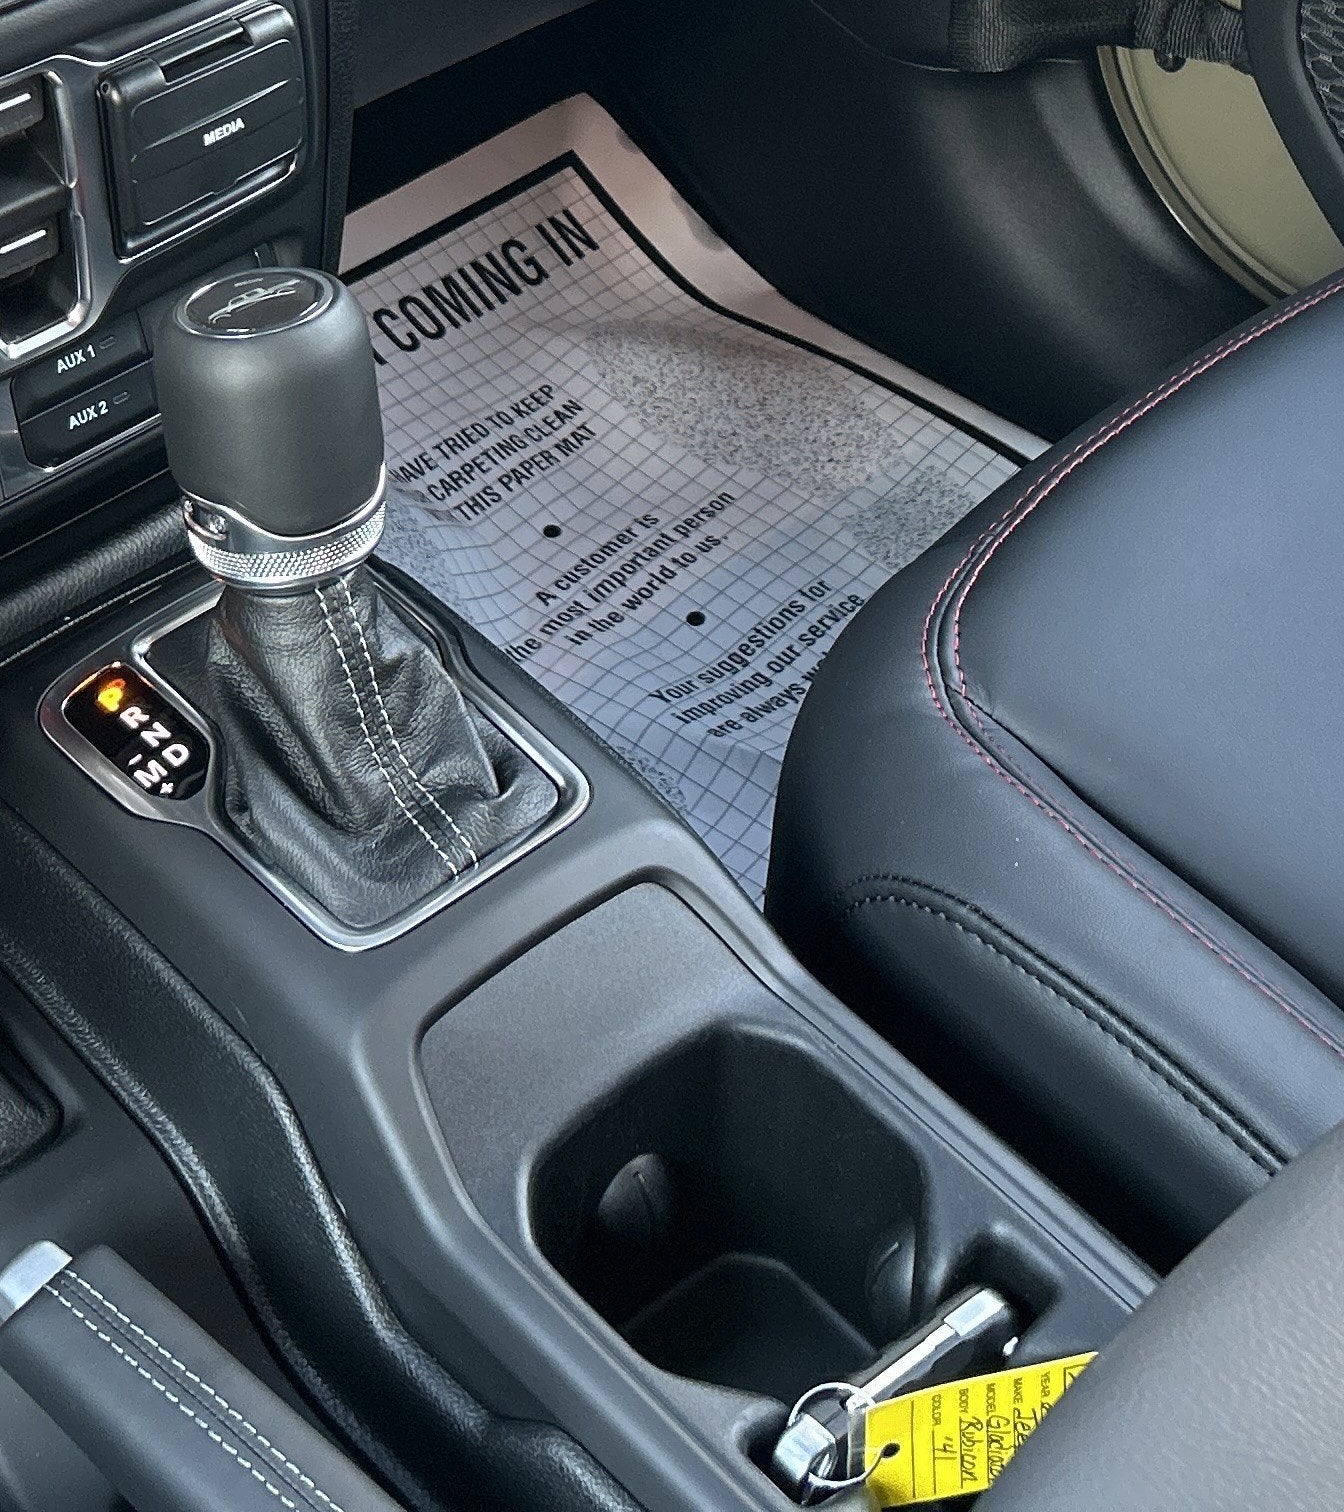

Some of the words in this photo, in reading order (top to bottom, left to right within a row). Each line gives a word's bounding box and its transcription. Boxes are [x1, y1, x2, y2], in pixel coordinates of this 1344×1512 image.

[202, 116, 246, 146] MEDIA
[374, 238, 550, 354] COMING
[540, 210, 600, 271] IN
[56, 350, 86, 374] AUX
[87, 345, 96, 360] 1
[67, 408, 97, 431] AUX
[98, 401, 109, 418] 2
[431, 422, 491, 462] TRIED
[485, 410, 516, 431] TO
[510, 384, 556, 419] KEEP
[426, 434, 528, 502] CARPETING
[523, 399, 584, 443] CLEAN
[454, 483, 503, 522] THIS
[497, 448, 561, 494] PAPER
[554, 422, 598, 458] MAT
[535, 590, 558, 607] A
[554, 527, 640, 592] customer
[634, 512, 660, 530] is
[538, 599, 592, 637] most
[583, 533, 678, 604] important
[671, 490, 737, 539] person
[564, 630, 594, 647] in
[586, 609, 626, 634] the
[621, 563, 679, 612] world
[670, 550, 698, 569] to
[648, 677, 702, 705] Your
[696, 598, 808, 685] suggestions
[800, 578, 834, 603] for
[674, 670, 774, 725] improving
[766, 642, 803, 675] our
[797, 592, 866, 648] service
[119, 705, 149, 730] R
[706, 717, 744, 739] are
[739, 684, 807, 726] always
[141, 722, 171, 747] N
[160, 743, 191, 768] D
[132, 760, 169, 789] M
[959, 1387, 970, 1414] BODY
[986, 1382, 998, 1418] MODEL
[1013, 1377, 1024, 1405] MAKE
[1042, 1370, 1051, 1399] YEAR
[931, 1394, 943, 1427] COLOR
